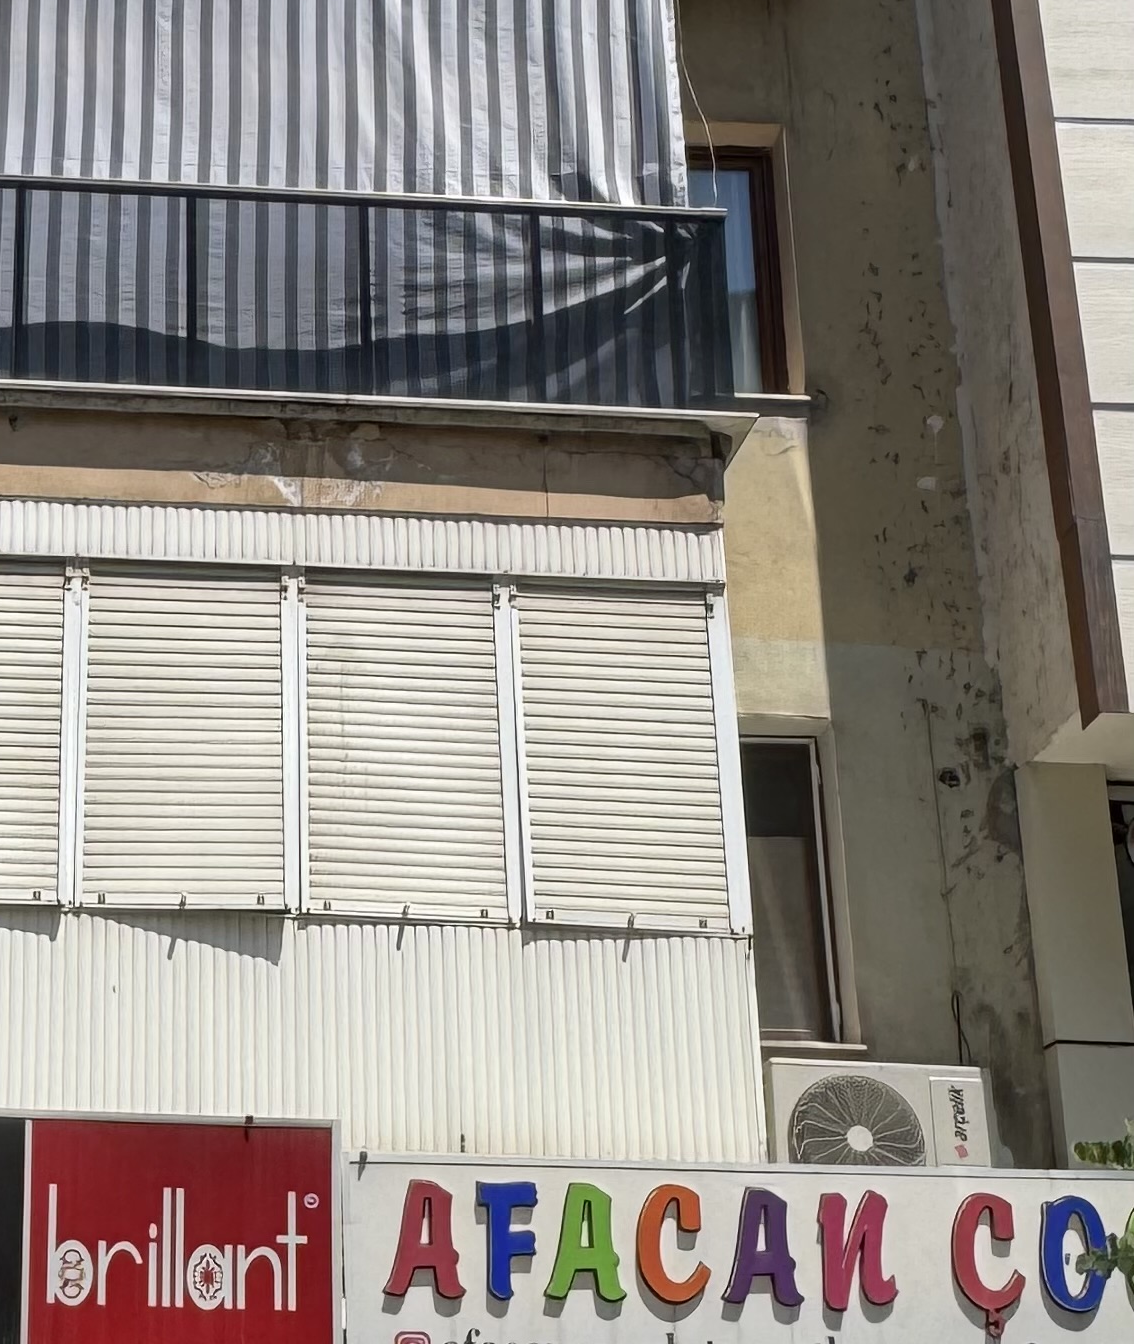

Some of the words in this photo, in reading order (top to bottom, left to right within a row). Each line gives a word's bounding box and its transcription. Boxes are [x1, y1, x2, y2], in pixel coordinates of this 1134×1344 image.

[46, 1183, 308, 1312] brillant
[383, 1179, 898, 1313] AFACAN
[951, 1192, 1134, 1338] ÇO
